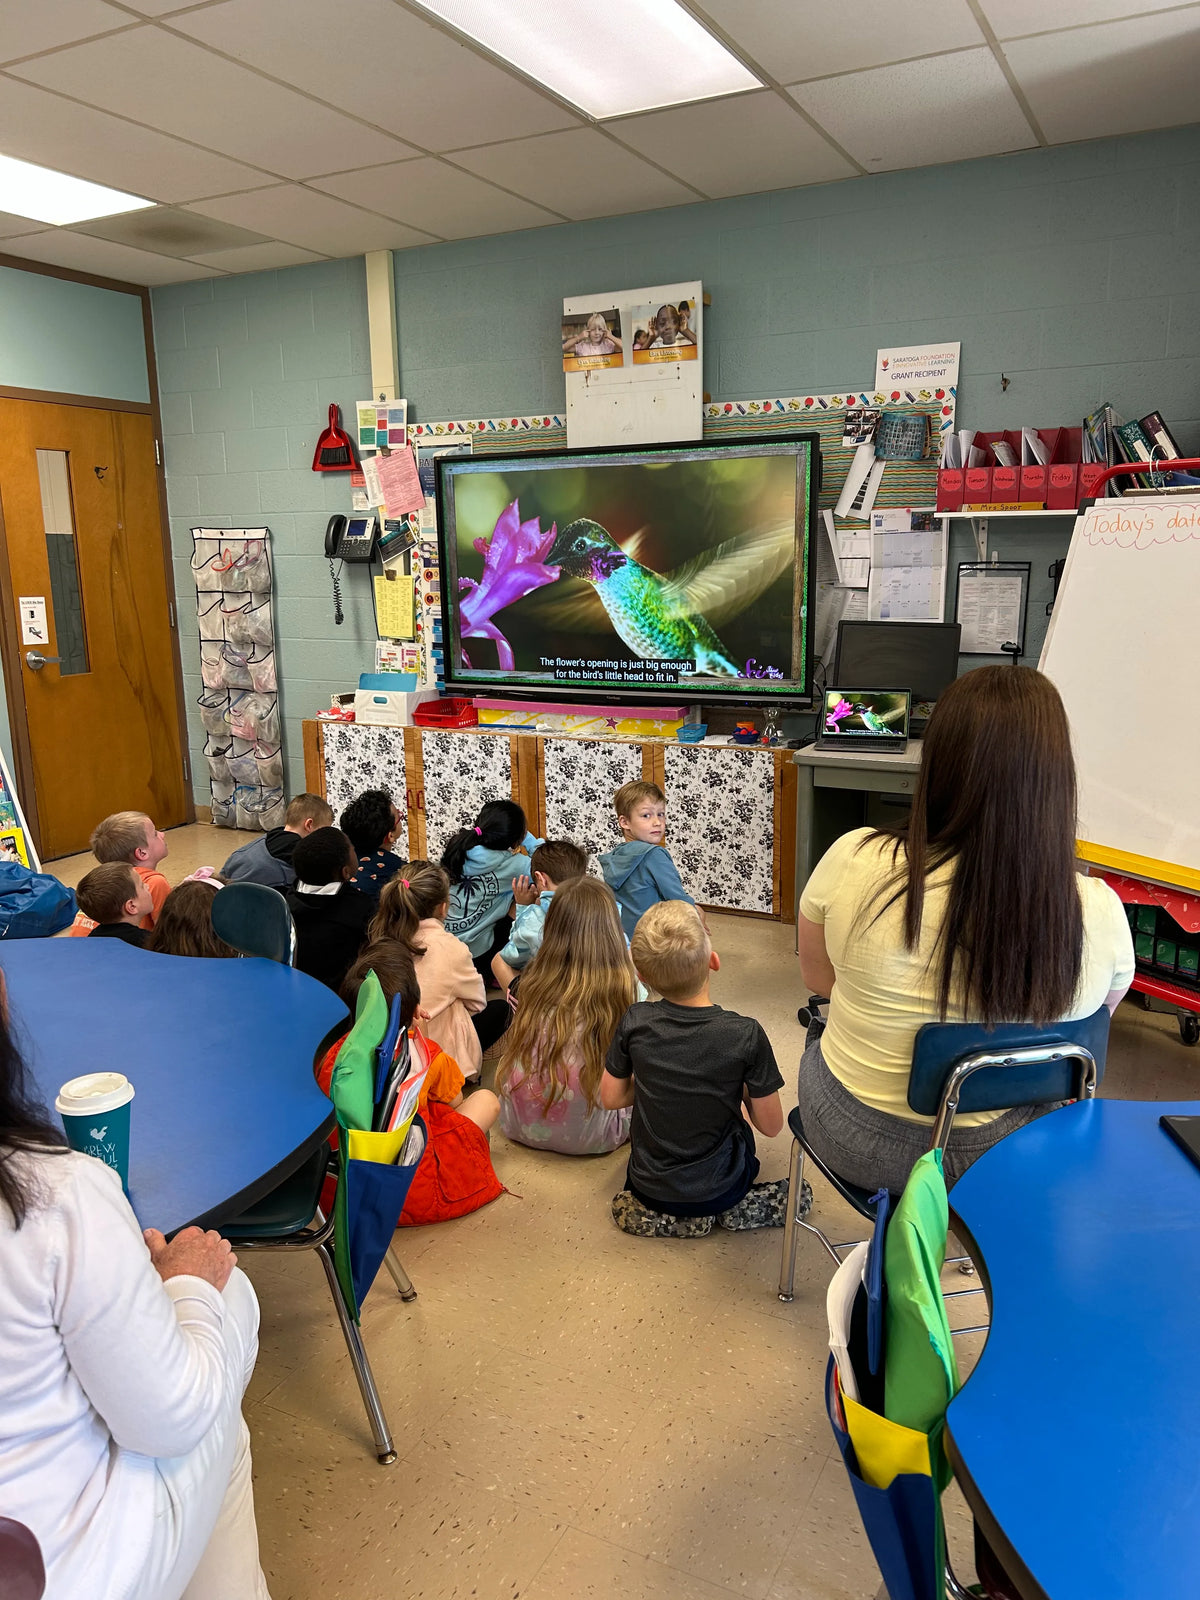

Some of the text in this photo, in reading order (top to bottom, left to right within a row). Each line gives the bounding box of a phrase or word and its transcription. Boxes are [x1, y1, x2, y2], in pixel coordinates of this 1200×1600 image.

[920, 353, 955, 361] FOUNDATION
[891, 369, 947, 380] GRANT RECIPIENT
[1051, 472, 1071, 482] Friday
[1092, 513, 1154, 539] Today's
[540, 657, 692, 672] The flower's opening is just big enough
[556, 669, 676, 682] for the bird's little head to fit in.
